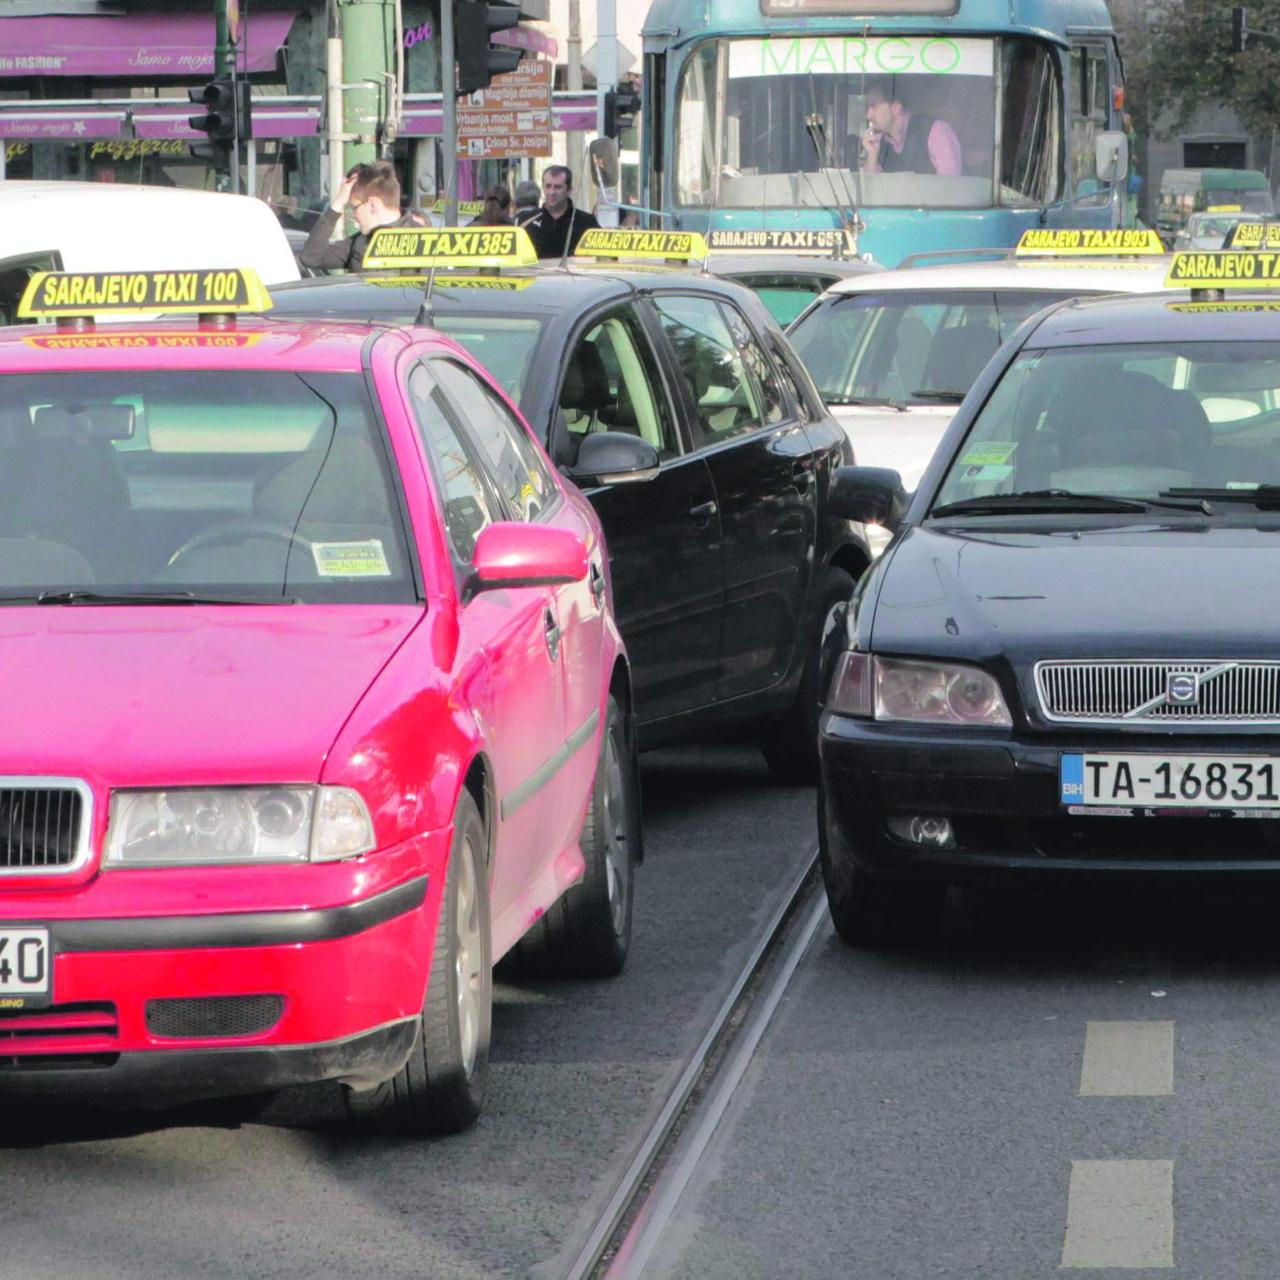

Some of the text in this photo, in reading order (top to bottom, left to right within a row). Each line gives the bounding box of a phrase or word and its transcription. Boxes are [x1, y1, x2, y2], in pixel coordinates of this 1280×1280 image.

[761, 37, 961, 74] MARGO
[491, 111, 514, 124] most
[375, 232, 514, 256] SARAJEVO TAXI 385
[584, 233, 690, 252] SARAJEVO TAXI 739
[1025, 231, 1148, 248] SARAJEVO TAXI 903
[1177, 254, 1256, 279] SARAJEVO
[44, 272, 238, 306] SARAJEVO TAXI 100
[1062, 783, 1083, 795] BIH
